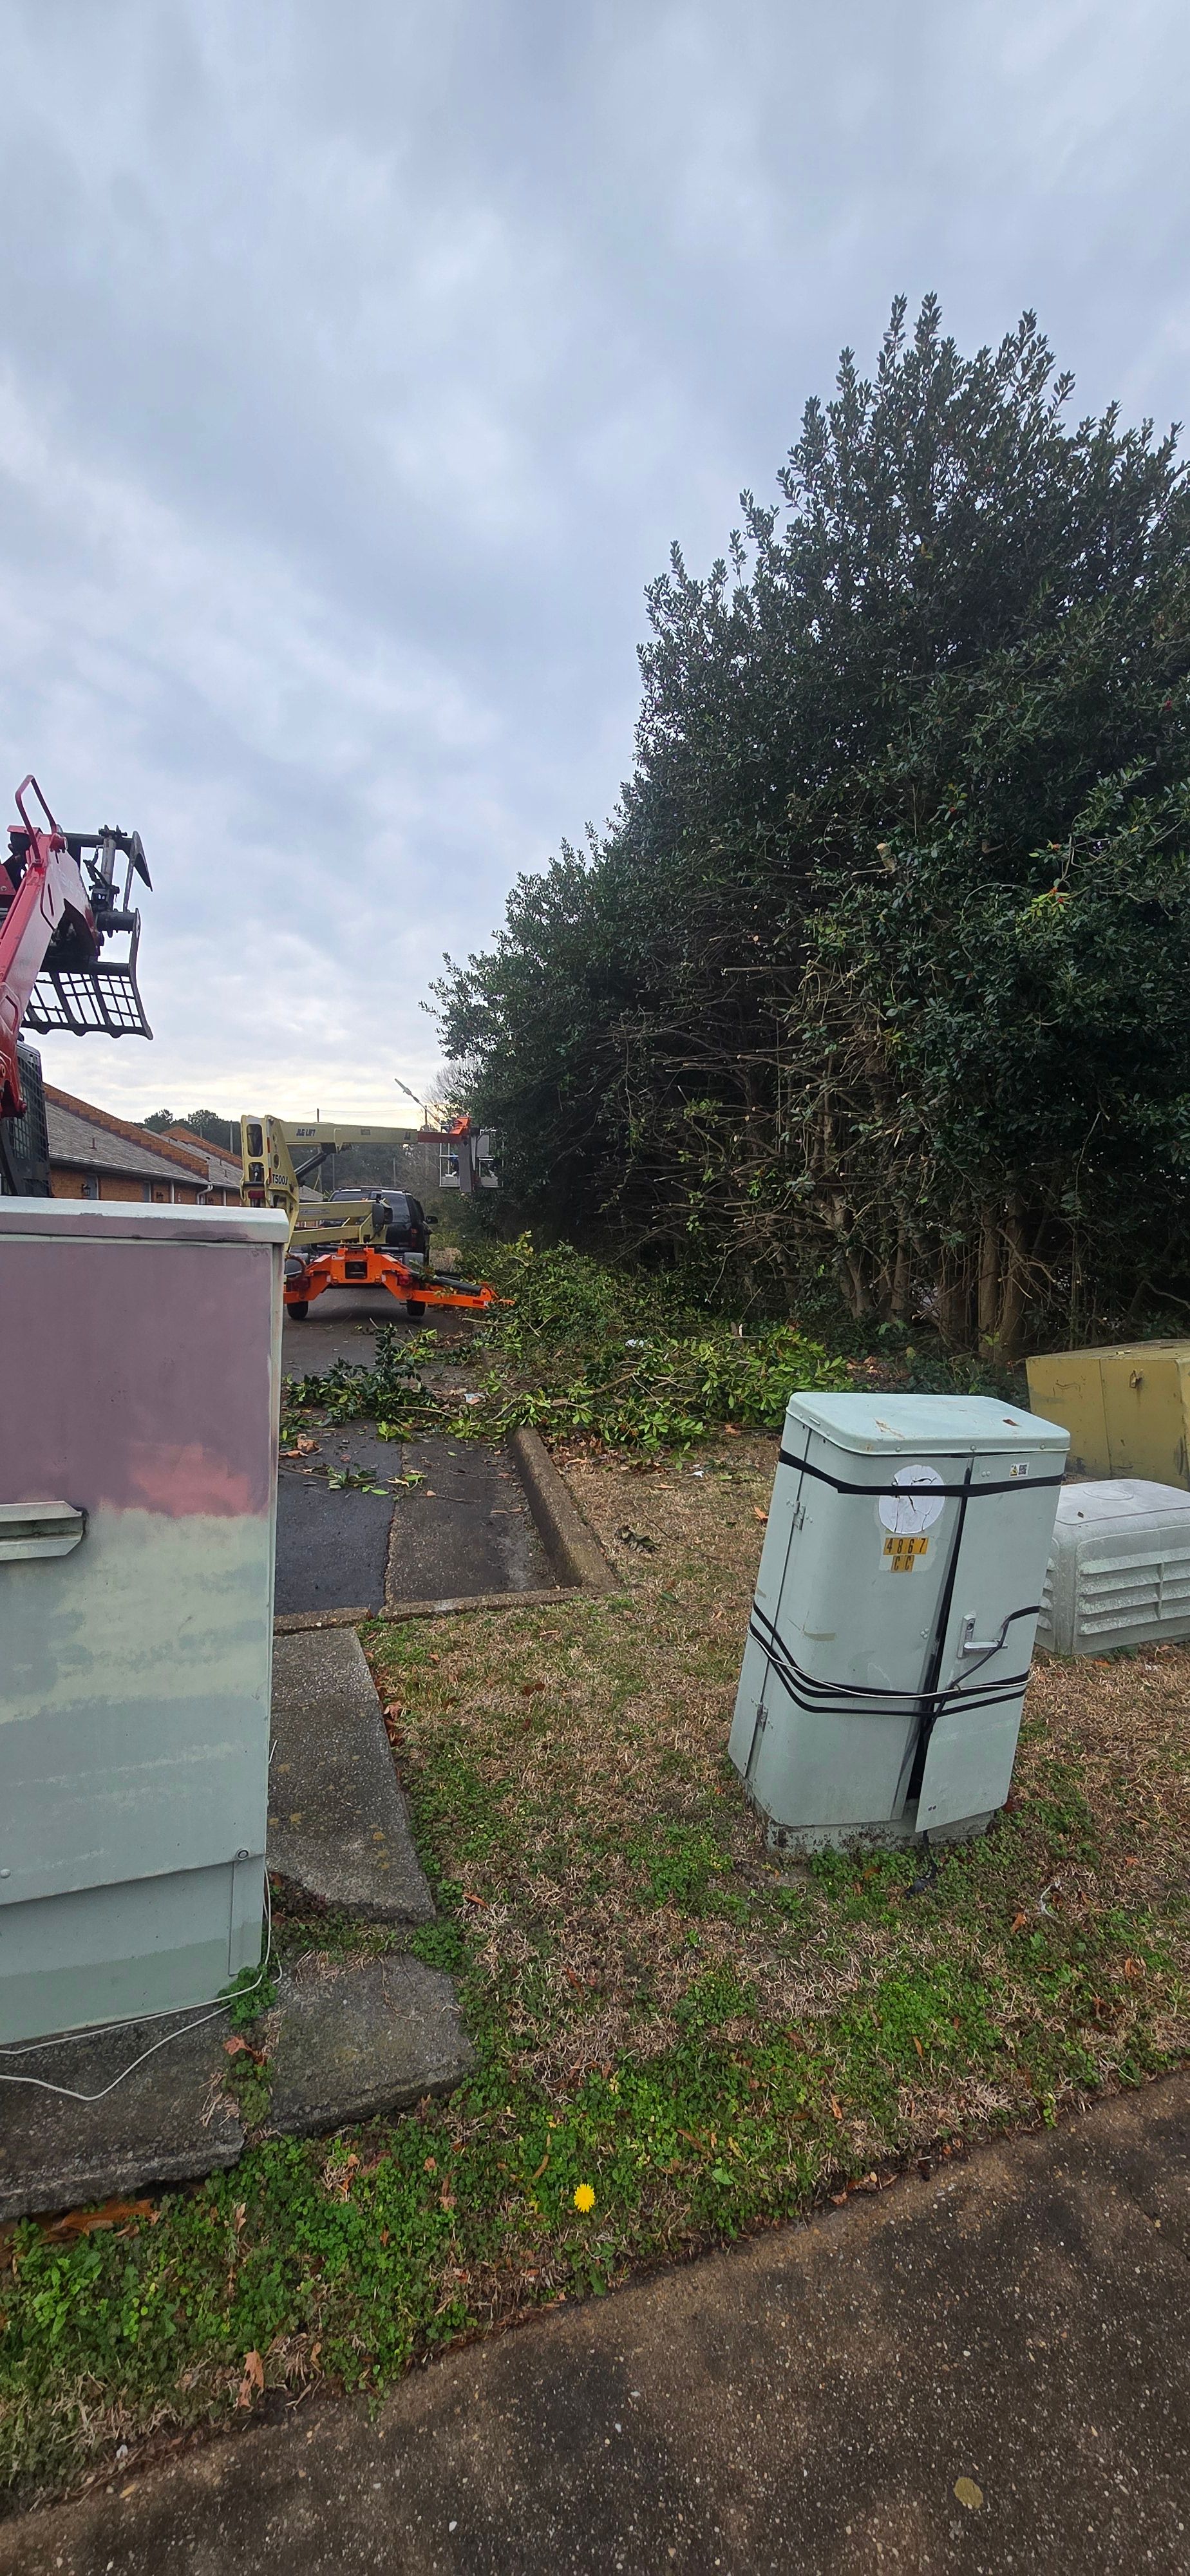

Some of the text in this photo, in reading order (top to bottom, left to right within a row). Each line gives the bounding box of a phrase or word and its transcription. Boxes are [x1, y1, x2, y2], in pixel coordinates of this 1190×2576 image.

[296, 1128, 316, 1137] JLG LIFT
[272, 1174, 288, 1186] T500J
[886, 1538, 926, 1554] 4867
